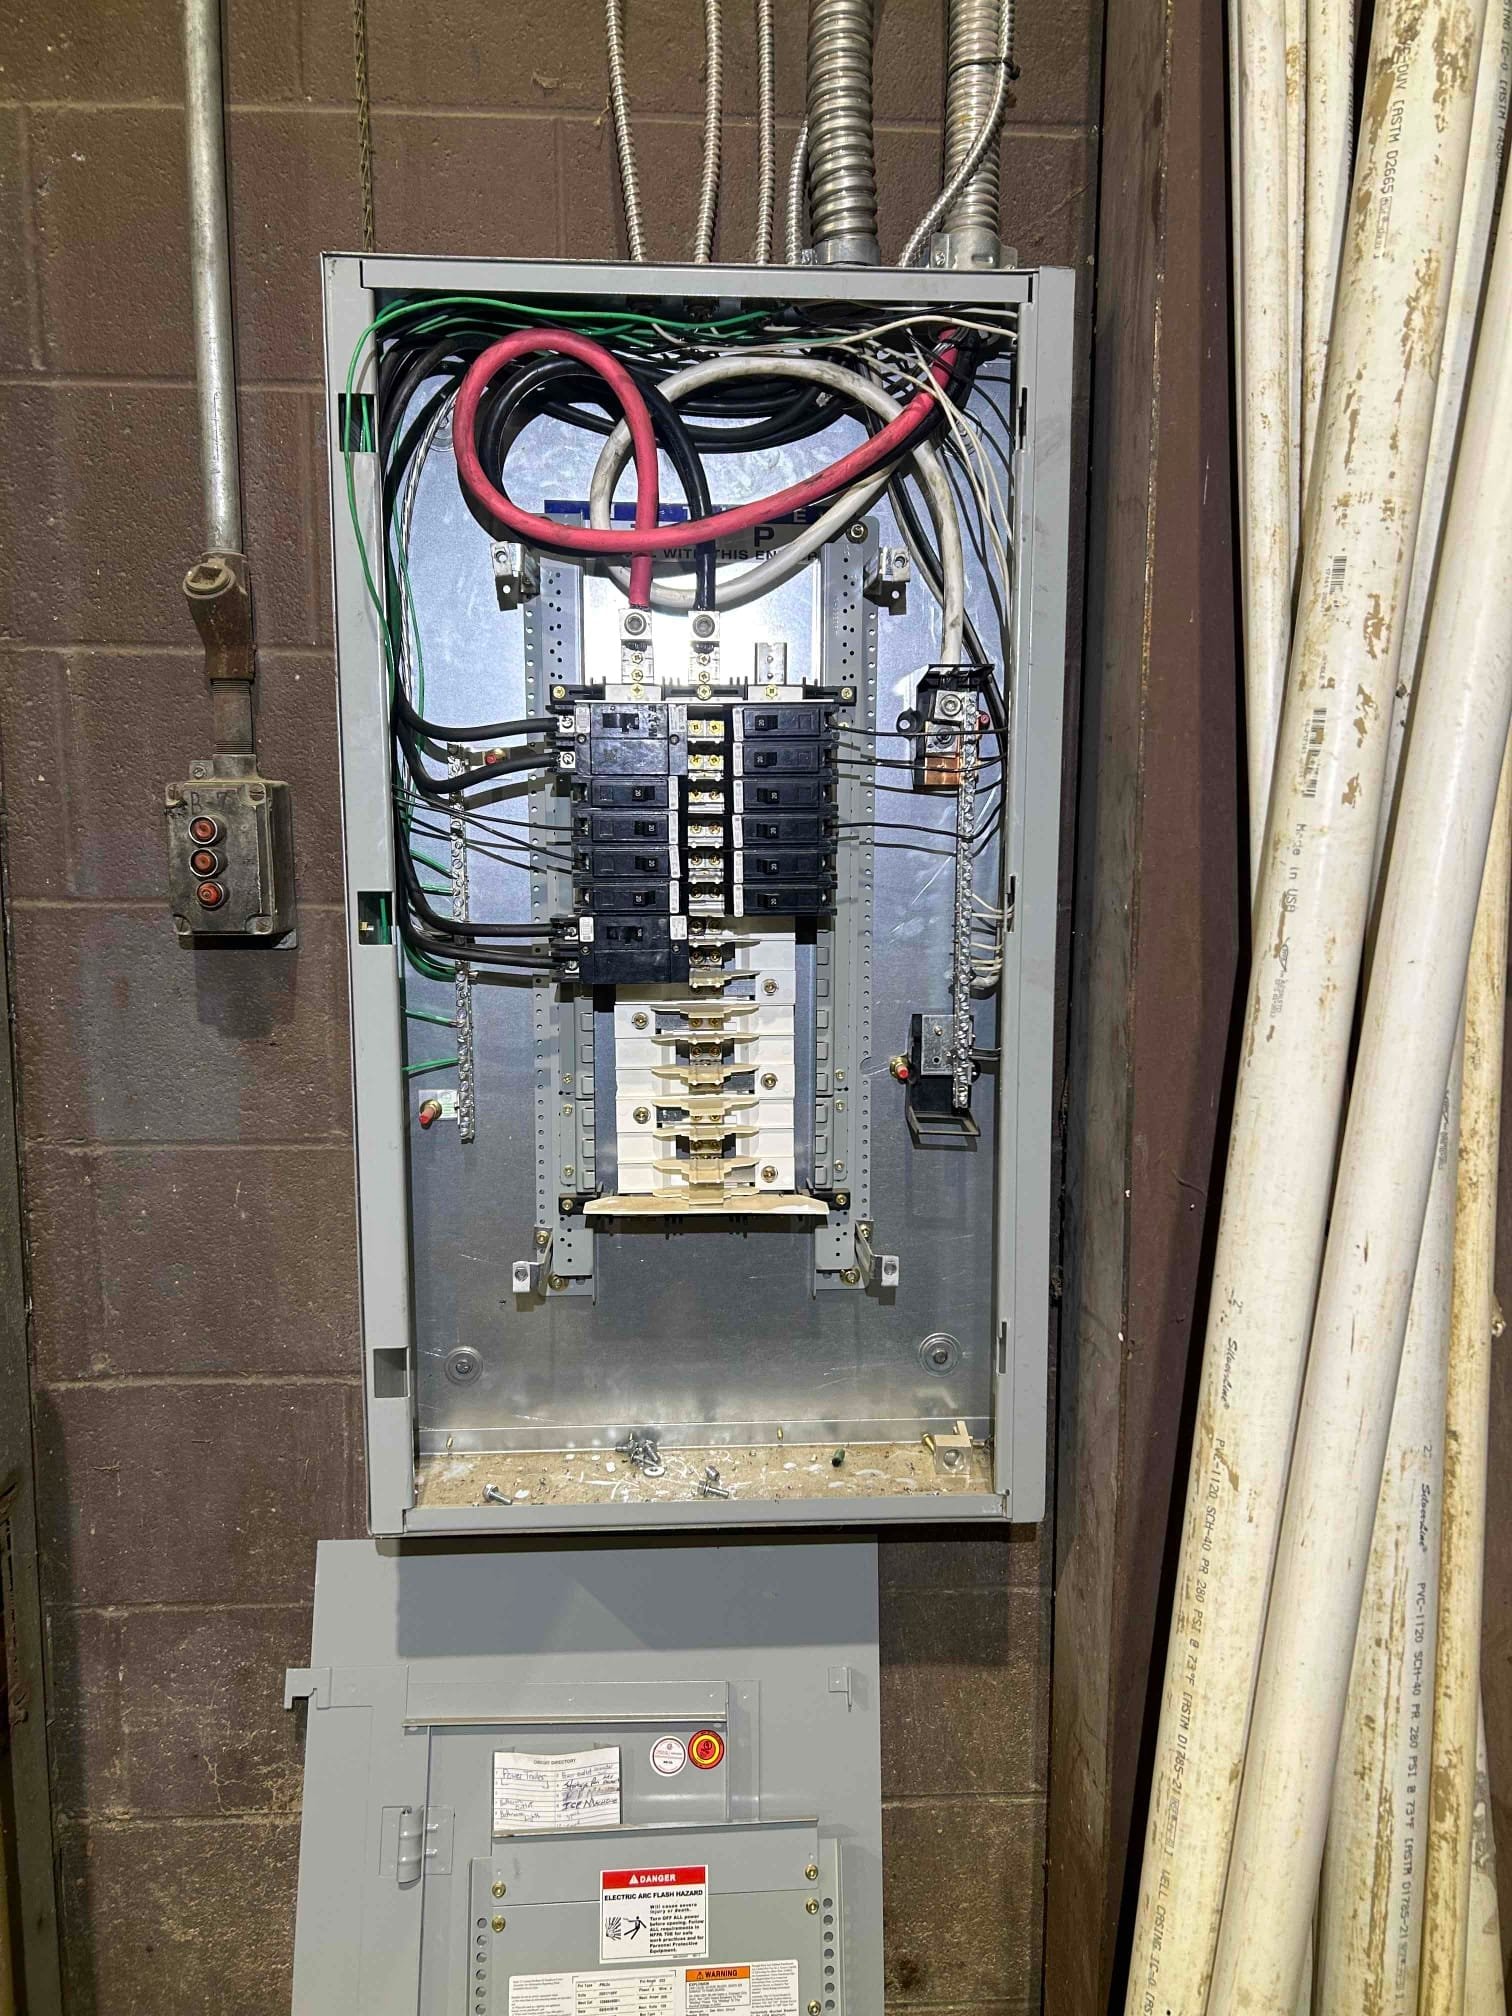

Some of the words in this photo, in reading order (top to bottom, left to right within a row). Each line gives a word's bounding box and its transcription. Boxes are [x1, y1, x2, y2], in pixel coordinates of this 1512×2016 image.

[1388, 100, 1406, 144] [ASTM
[1381, 150, 1398, 194] D2665
[755, 550, 777, 560] EN
[1288, 866, 1300, 880] in
[1286, 888, 1299, 912] USA
[1202, 1506, 1216, 1552] SCH-40
[1199, 1558, 1210, 1574] PR
[1194, 1580, 1207, 1603] 280
[1190, 1608, 1204, 1632] PSI
[1414, 1582, 1426, 1644] PVC-1120
[1412, 1651, 1422, 1696] SCH-40
[1178, 1692, 1193, 1730] [ASTM
[1410, 1704, 1420, 1720] PR
[1409, 1726, 1420, 1748] 280
[1407, 1756, 1418, 1778] PSI
[1402, 1838, 1414, 1876] [ASTM
[639, 1874, 676, 1884] DANGER
[604, 1893, 637, 1901] ELECTRIC
[1152, 1904, 1166, 1952] CASING
[705, 1969, 738, 1979] WARNING
